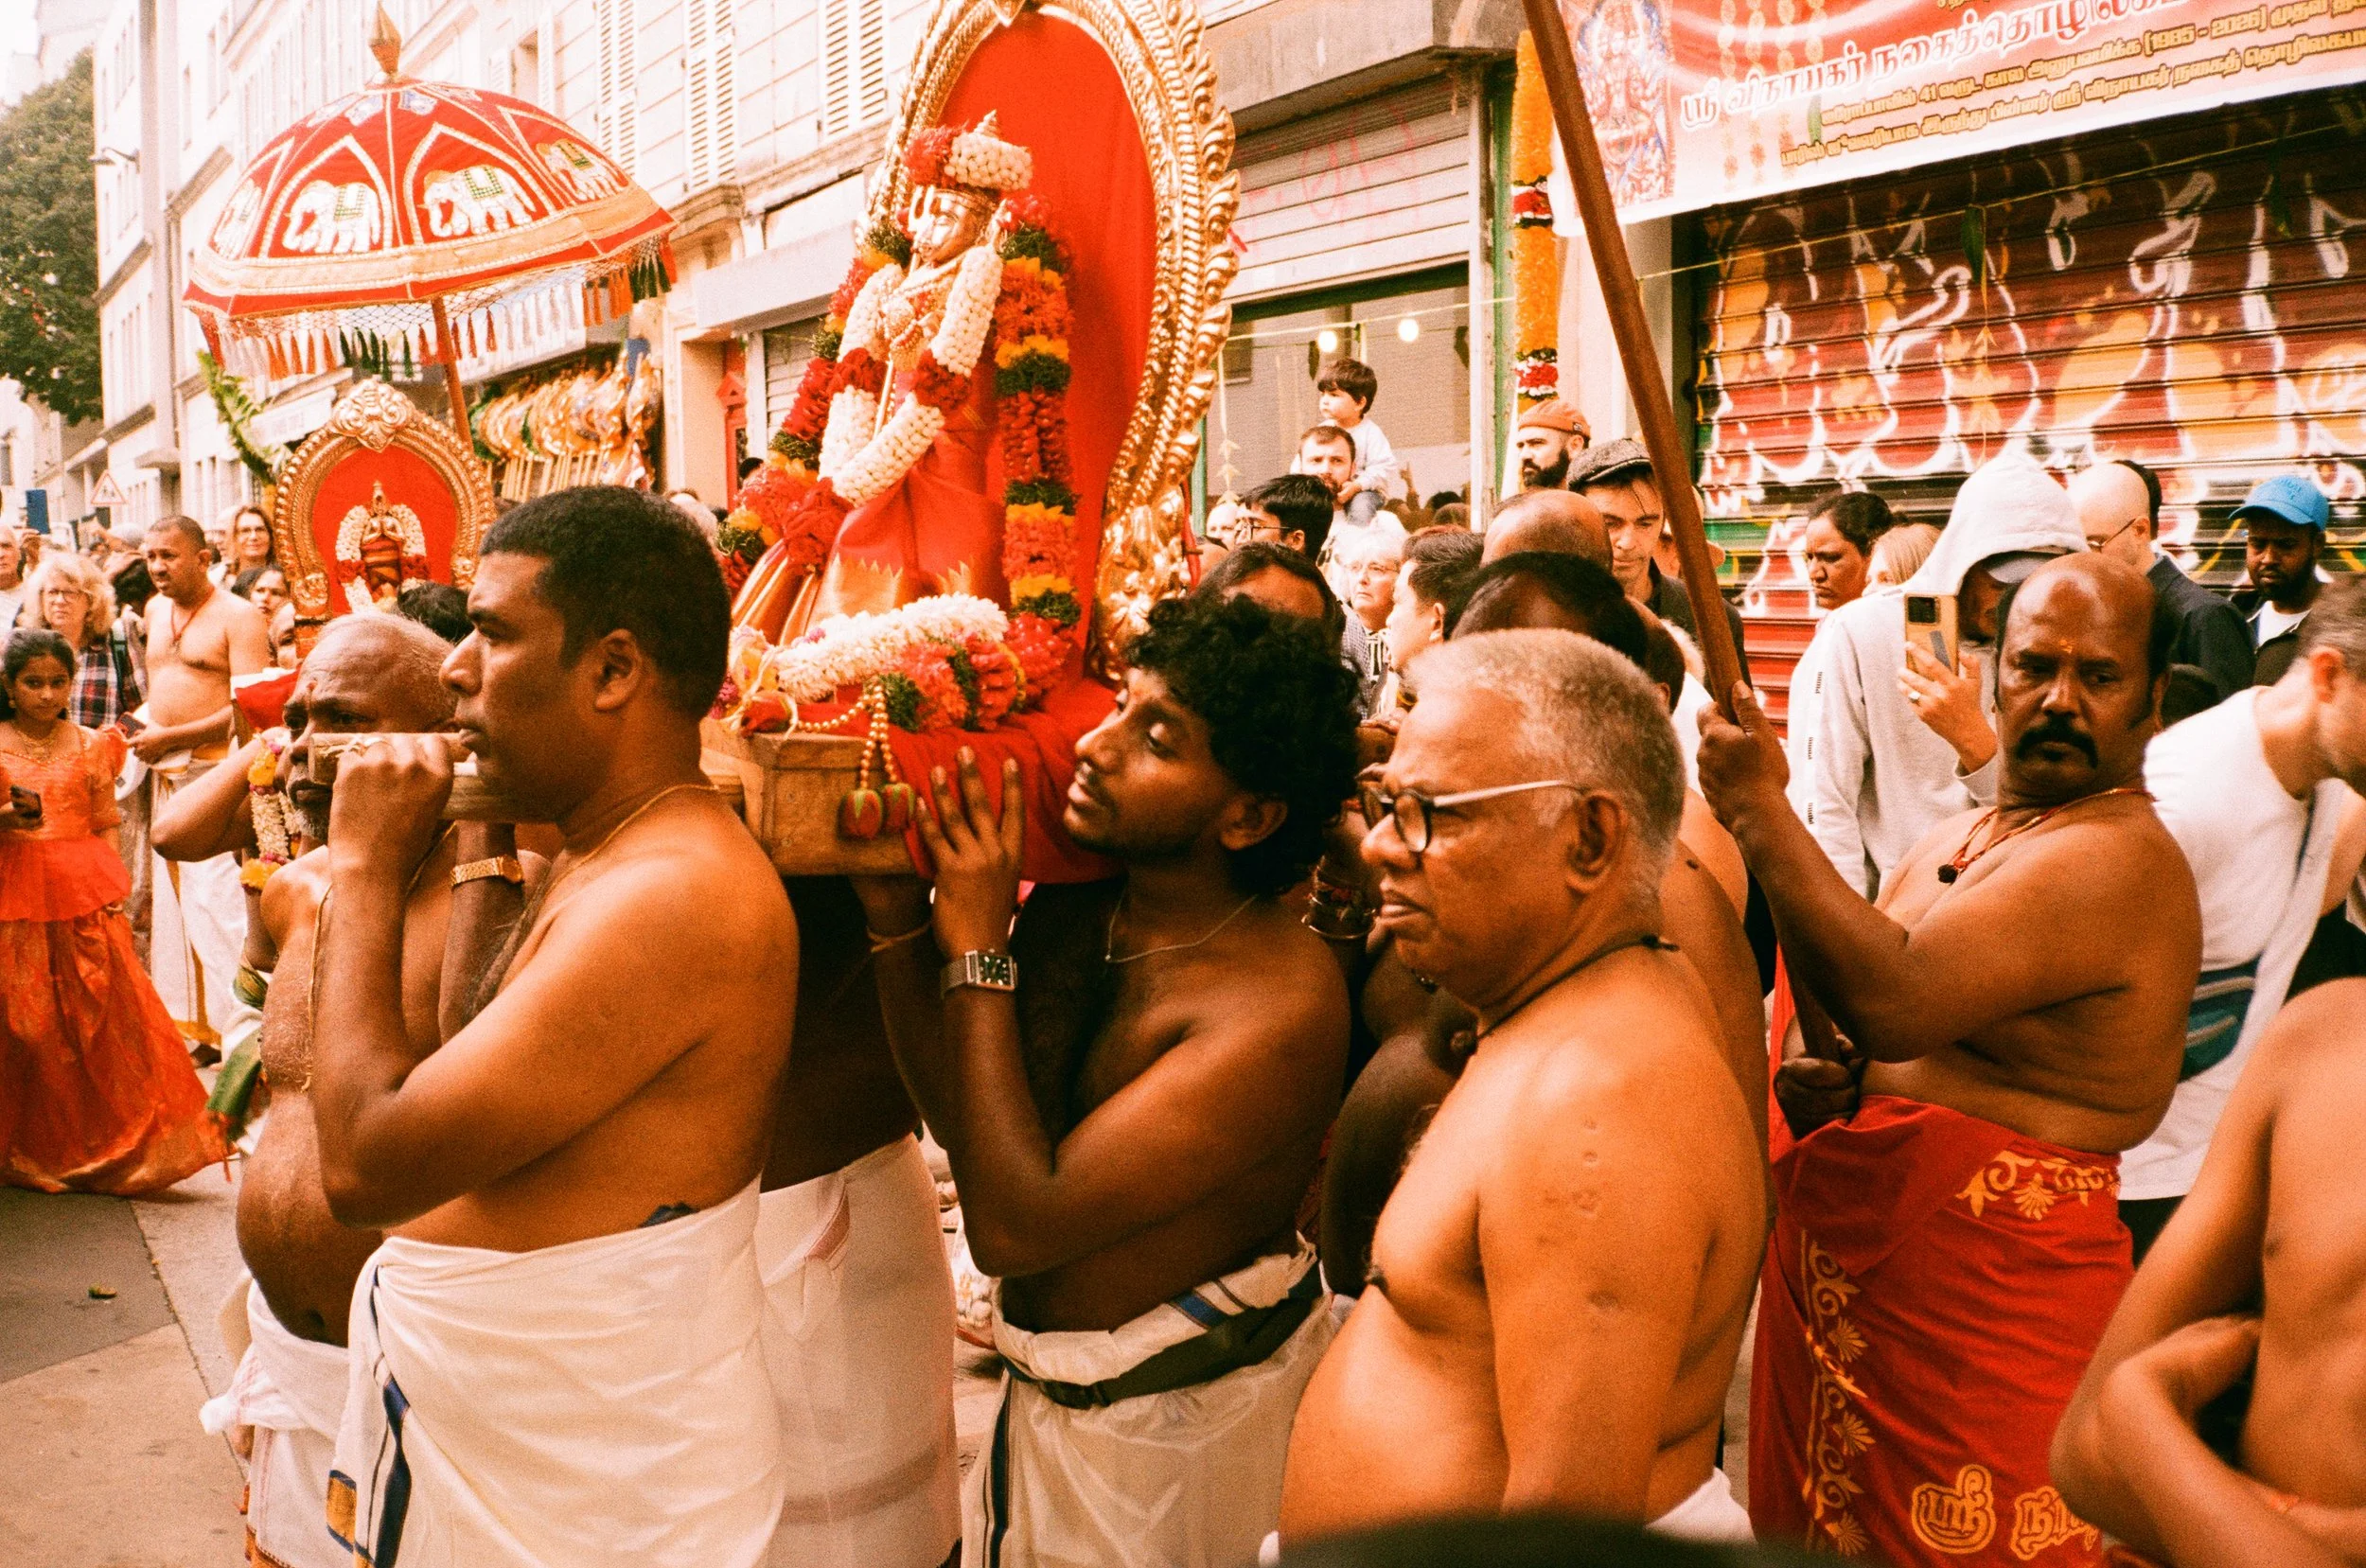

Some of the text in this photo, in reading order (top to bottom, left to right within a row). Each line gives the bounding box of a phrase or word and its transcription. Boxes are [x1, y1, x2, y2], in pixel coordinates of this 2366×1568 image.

[1725, 41, 1866, 115] விநாயகர்
[1918, 83, 1938, 103] 41
[1984, 66, 2026, 89] கால
[2027, 37, 2141, 80] அனுபவமிக்க
[1989, 91, 2052, 122] பின்னர்
[2083, 64, 2172, 103] விநாயகர்
[2172, 48, 2242, 88] நகைத்
